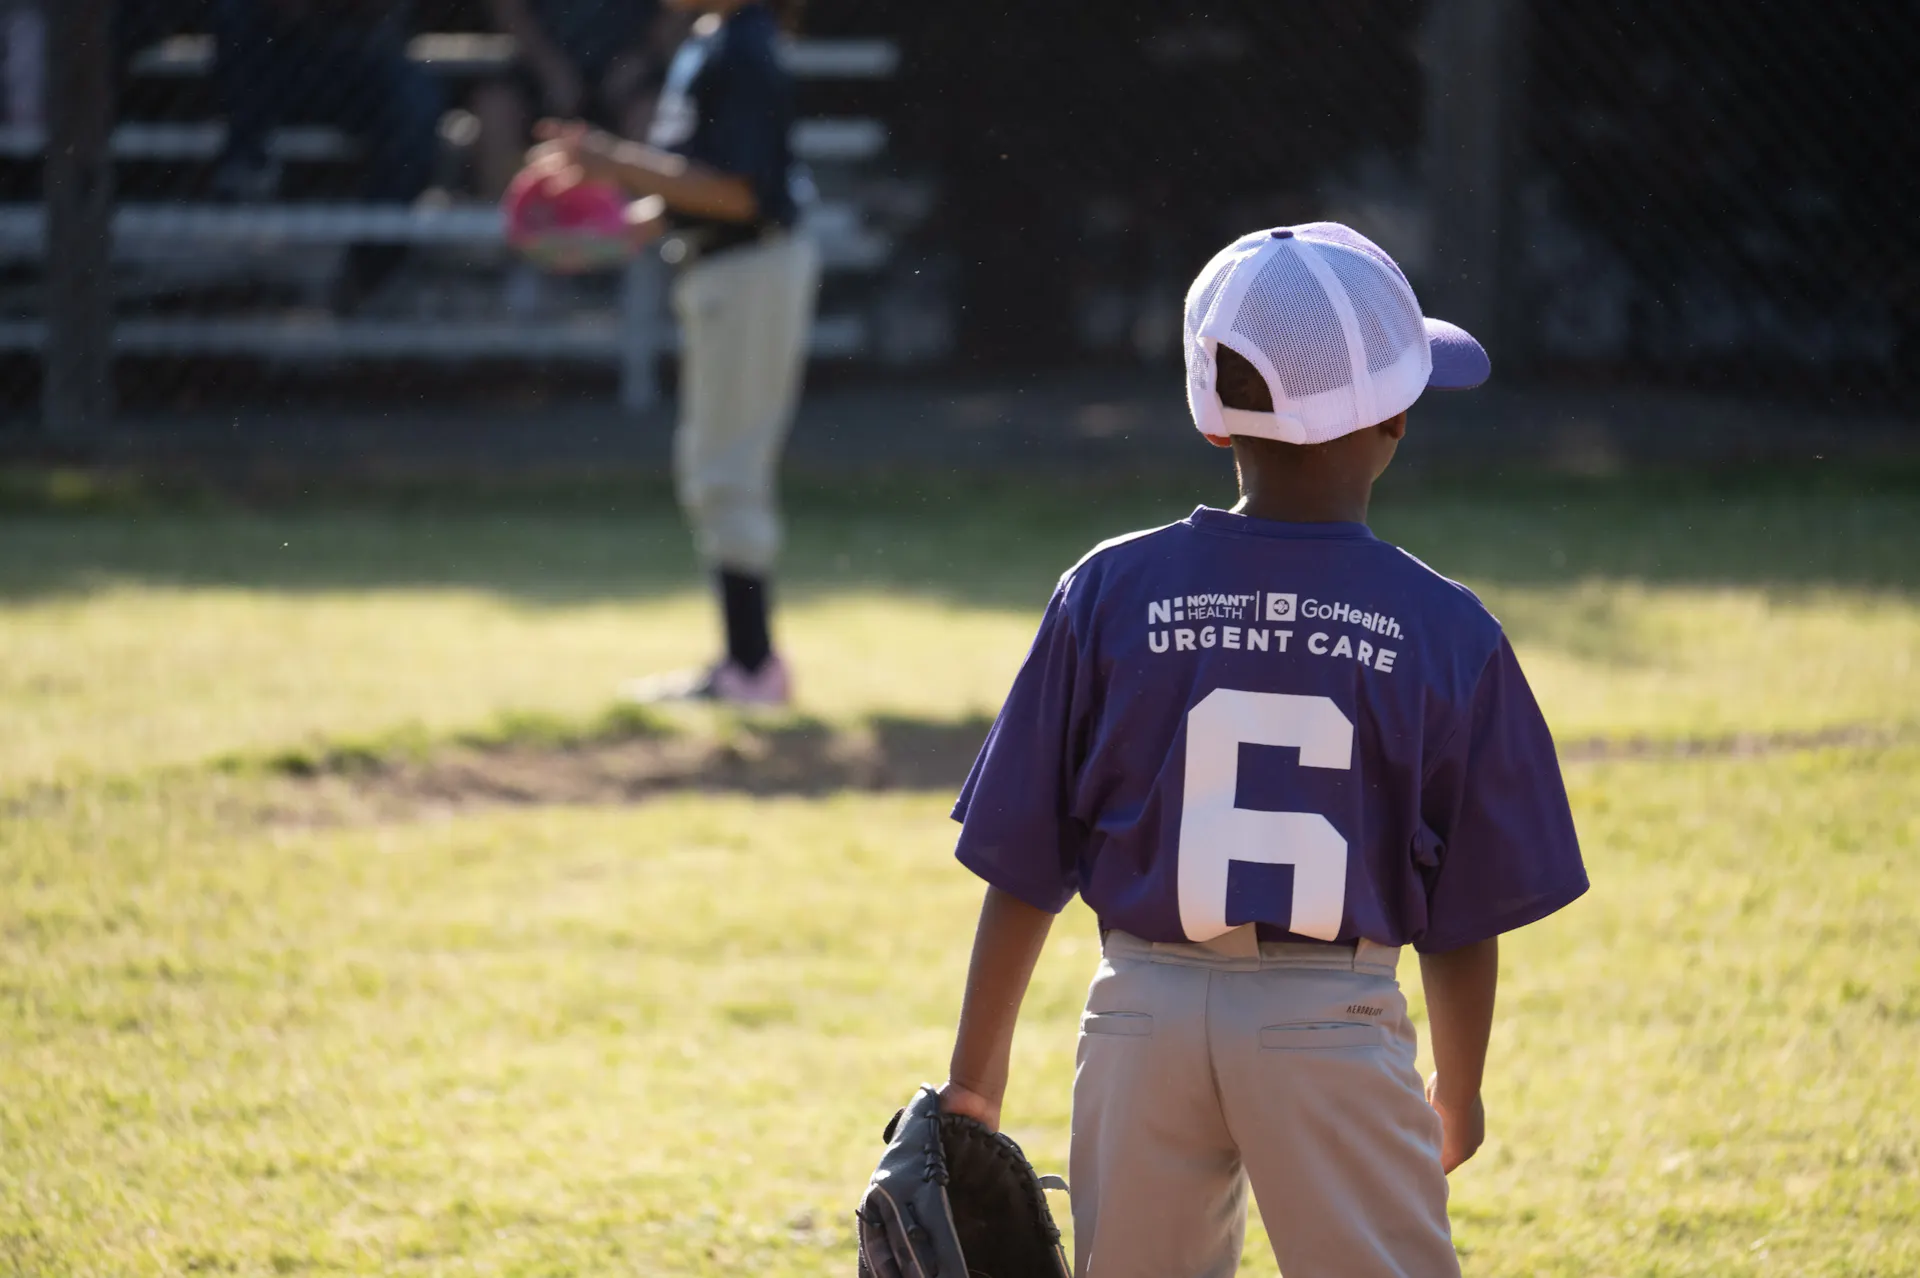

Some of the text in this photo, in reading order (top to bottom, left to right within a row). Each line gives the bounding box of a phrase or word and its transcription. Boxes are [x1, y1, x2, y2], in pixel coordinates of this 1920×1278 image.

[1187, 606, 1243, 620] HEALTH
[1148, 625, 1397, 673] URGENT CARE
[1177, 687, 1354, 942] 6
